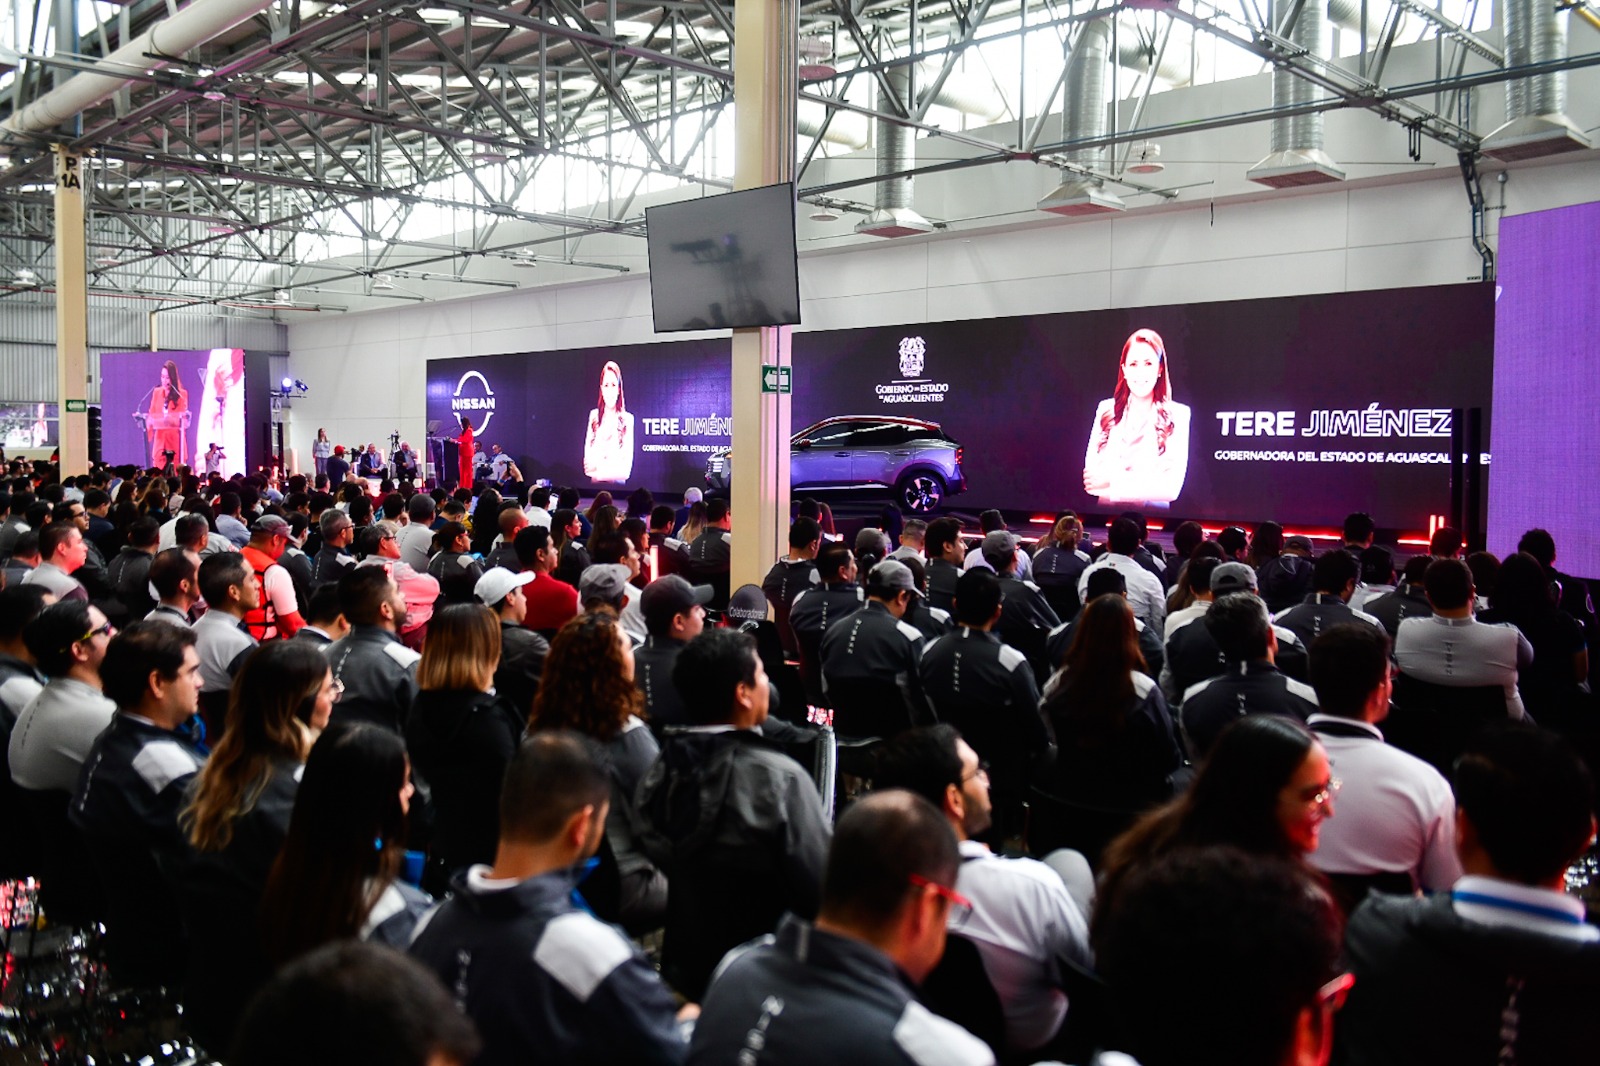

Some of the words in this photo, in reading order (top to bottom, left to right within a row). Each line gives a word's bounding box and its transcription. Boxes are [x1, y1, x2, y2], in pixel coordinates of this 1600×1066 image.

[61, 173, 80, 189] 1A
[875, 384, 914, 395] GOBIERNO
[920, 383, 949, 392] ESTADO
[451, 397, 496, 410] NISSAN
[883, 393, 945, 404] AGUASCALIENTES
[642, 418, 680, 436] TERE
[681, 412, 733, 436] JIMÉN
[1216, 411, 1296, 437] TERE
[1301, 402, 1452, 437] JIMÉNEZ
[642, 444, 680, 452] GOBERNADORA
[680, 444, 690, 452] DEL
[690, 444, 711, 453] ESTADO
[1214, 450, 1296, 462] GOBERNADORA
[1297, 451, 1319, 462] DEL
[1320, 451, 1366, 463] ESTADO
[1367, 452, 1385, 463] DE
[729, 606, 766, 620] Colaboradores
